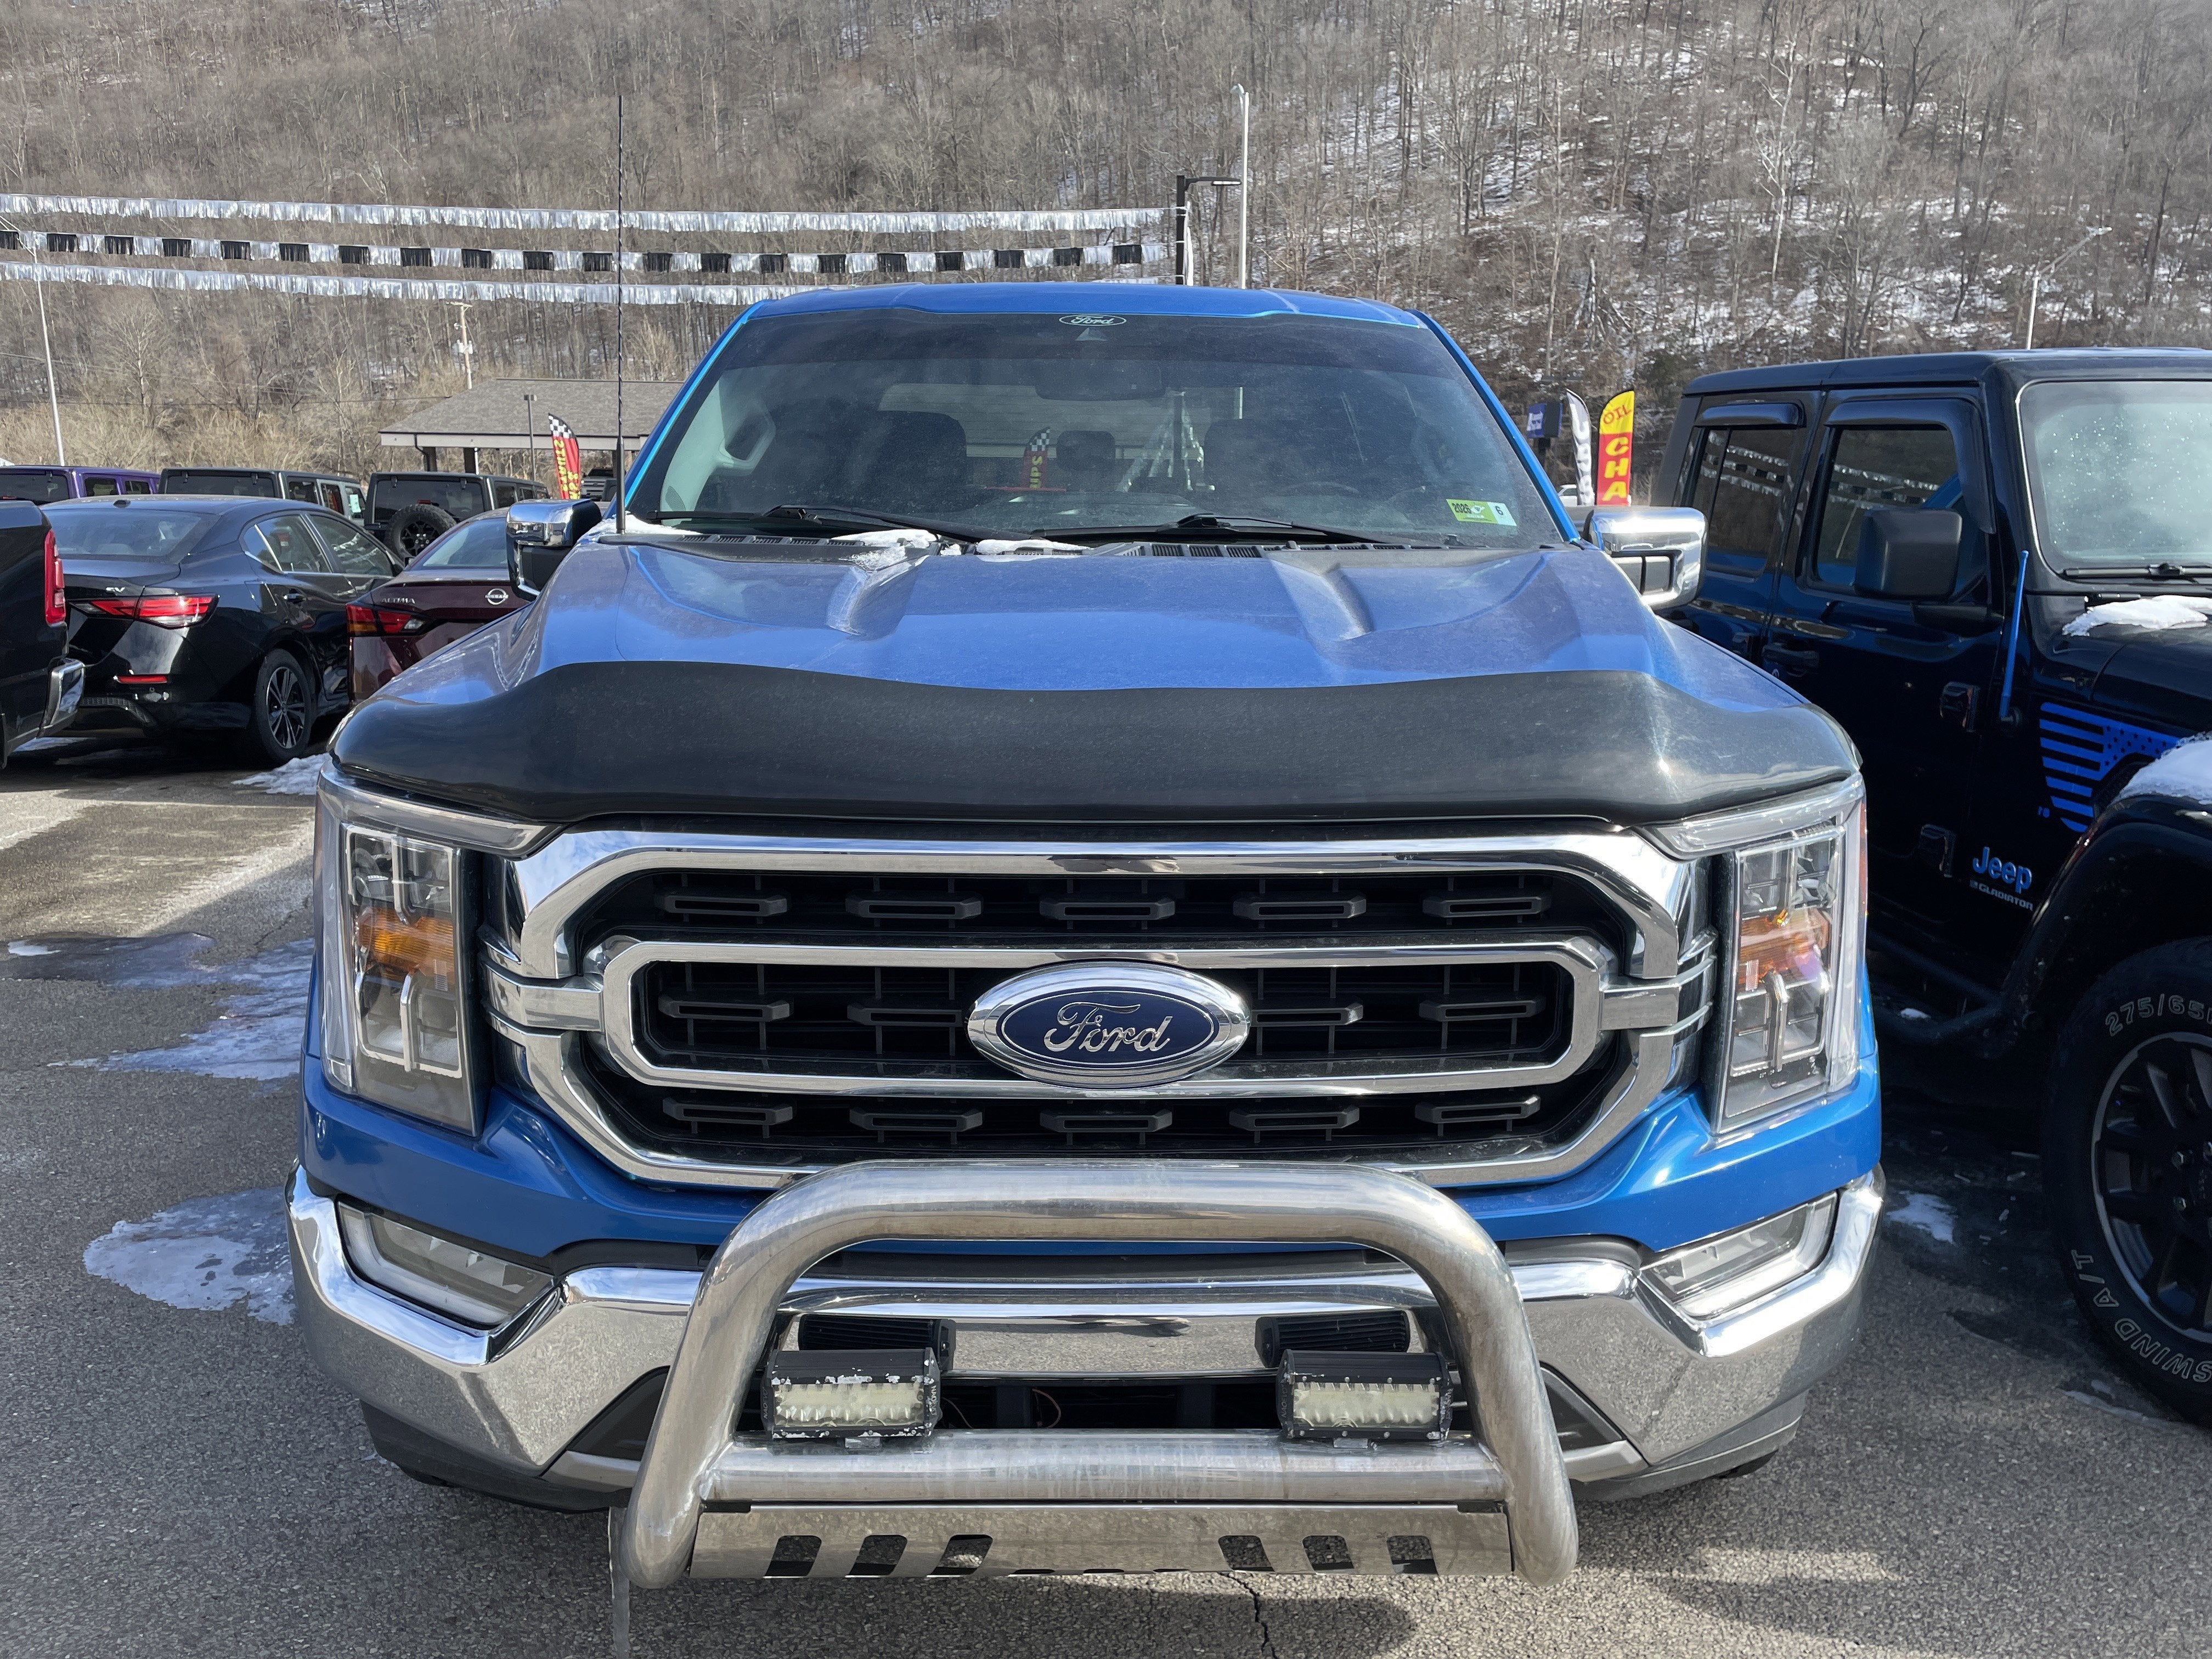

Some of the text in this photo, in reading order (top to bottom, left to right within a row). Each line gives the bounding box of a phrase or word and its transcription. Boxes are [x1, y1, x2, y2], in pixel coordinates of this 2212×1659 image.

[1071, 315, 1114, 324] Ford
[1603, 405, 1632, 425] OIL
[1029, 456, 1043, 489] UPS
[1452, 503, 1504, 516] 2026 6
[1972, 846, 2032, 894] Jeep
[1979, 883, 2033, 911] GLADIATOR
[1043, 1001, 1173, 1052] Ford
[2071, 1249, 2119, 1308] A/T
